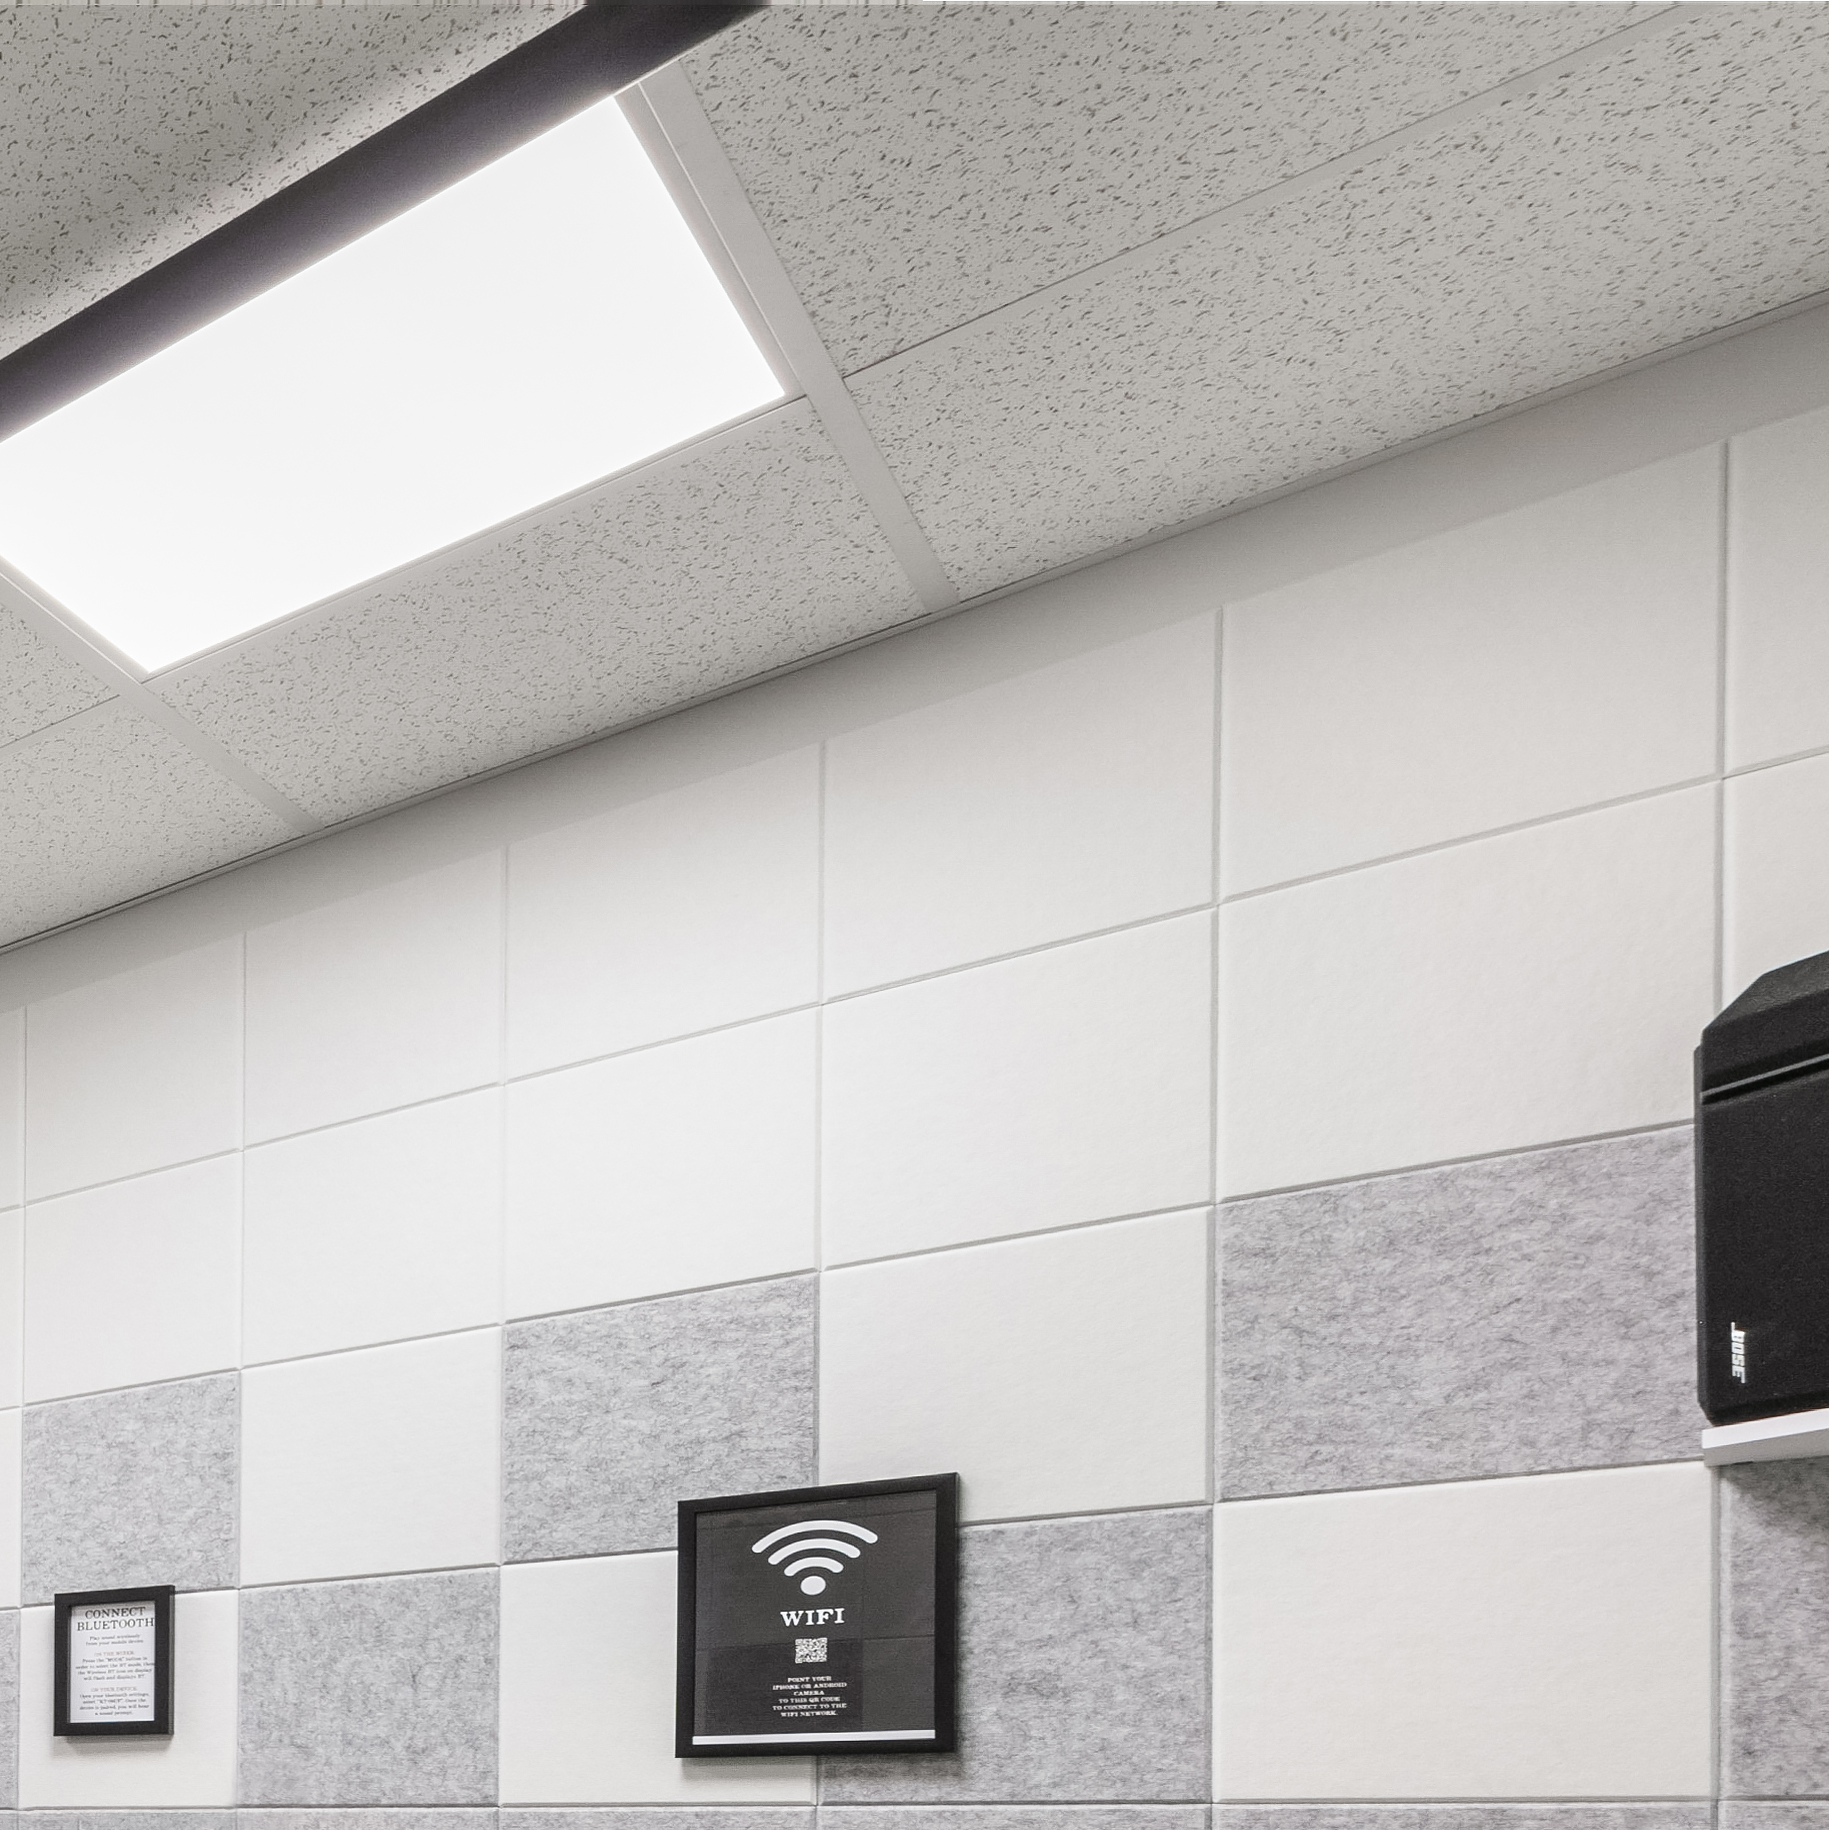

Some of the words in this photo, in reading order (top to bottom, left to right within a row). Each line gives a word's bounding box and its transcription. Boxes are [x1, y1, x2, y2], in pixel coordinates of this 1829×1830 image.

[1731, 1321, 1746, 1384] BOSE
[85, 1607, 145, 1619] CONNECT
[780, 1608, 845, 1626] WIFI
[77, 1618, 155, 1631] BLUETOOTH
